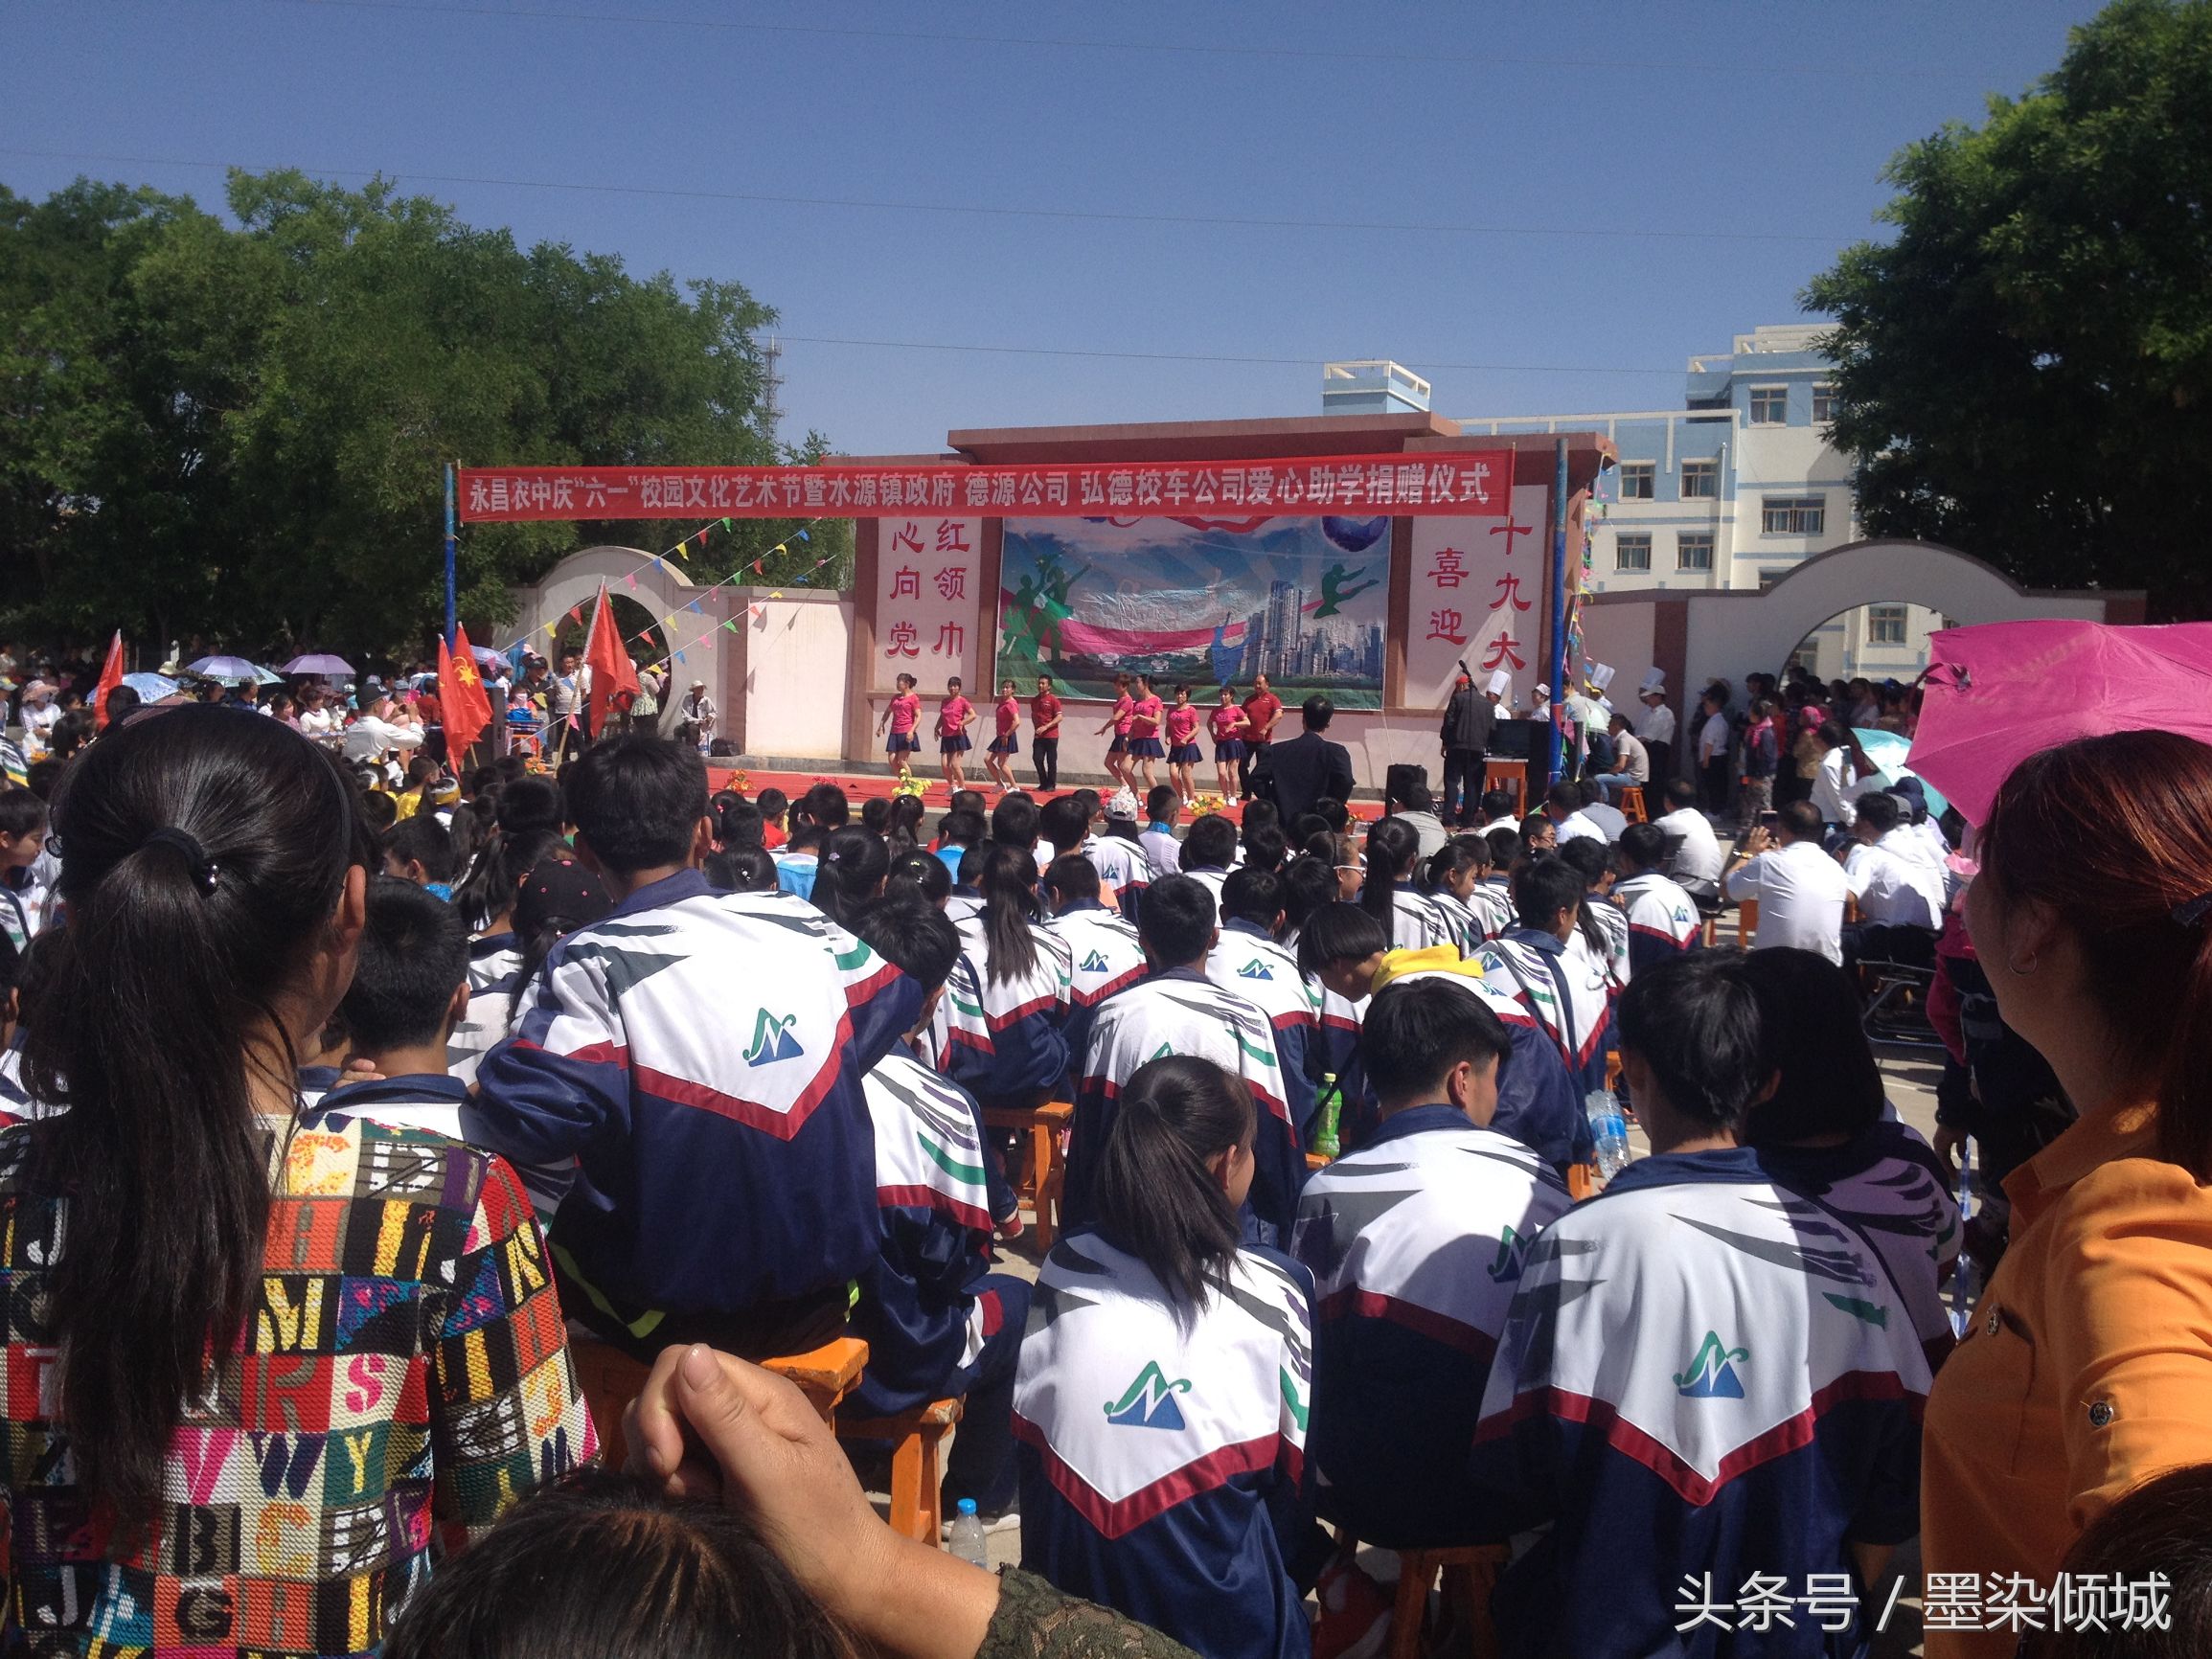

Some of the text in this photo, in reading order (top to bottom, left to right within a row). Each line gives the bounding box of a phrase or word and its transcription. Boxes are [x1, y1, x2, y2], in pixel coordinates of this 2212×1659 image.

[964, 470, 1070, 507] 德源公司
[1080, 463, 1491, 506] 弘德校车公司爱心助学捐赠仪式
[887, 521, 925, 656] 心向党
[933, 519, 970, 656] 红领巾
[1426, 547, 1470, 646] 喜迎
[1483, 515, 1534, 670] 十九大
